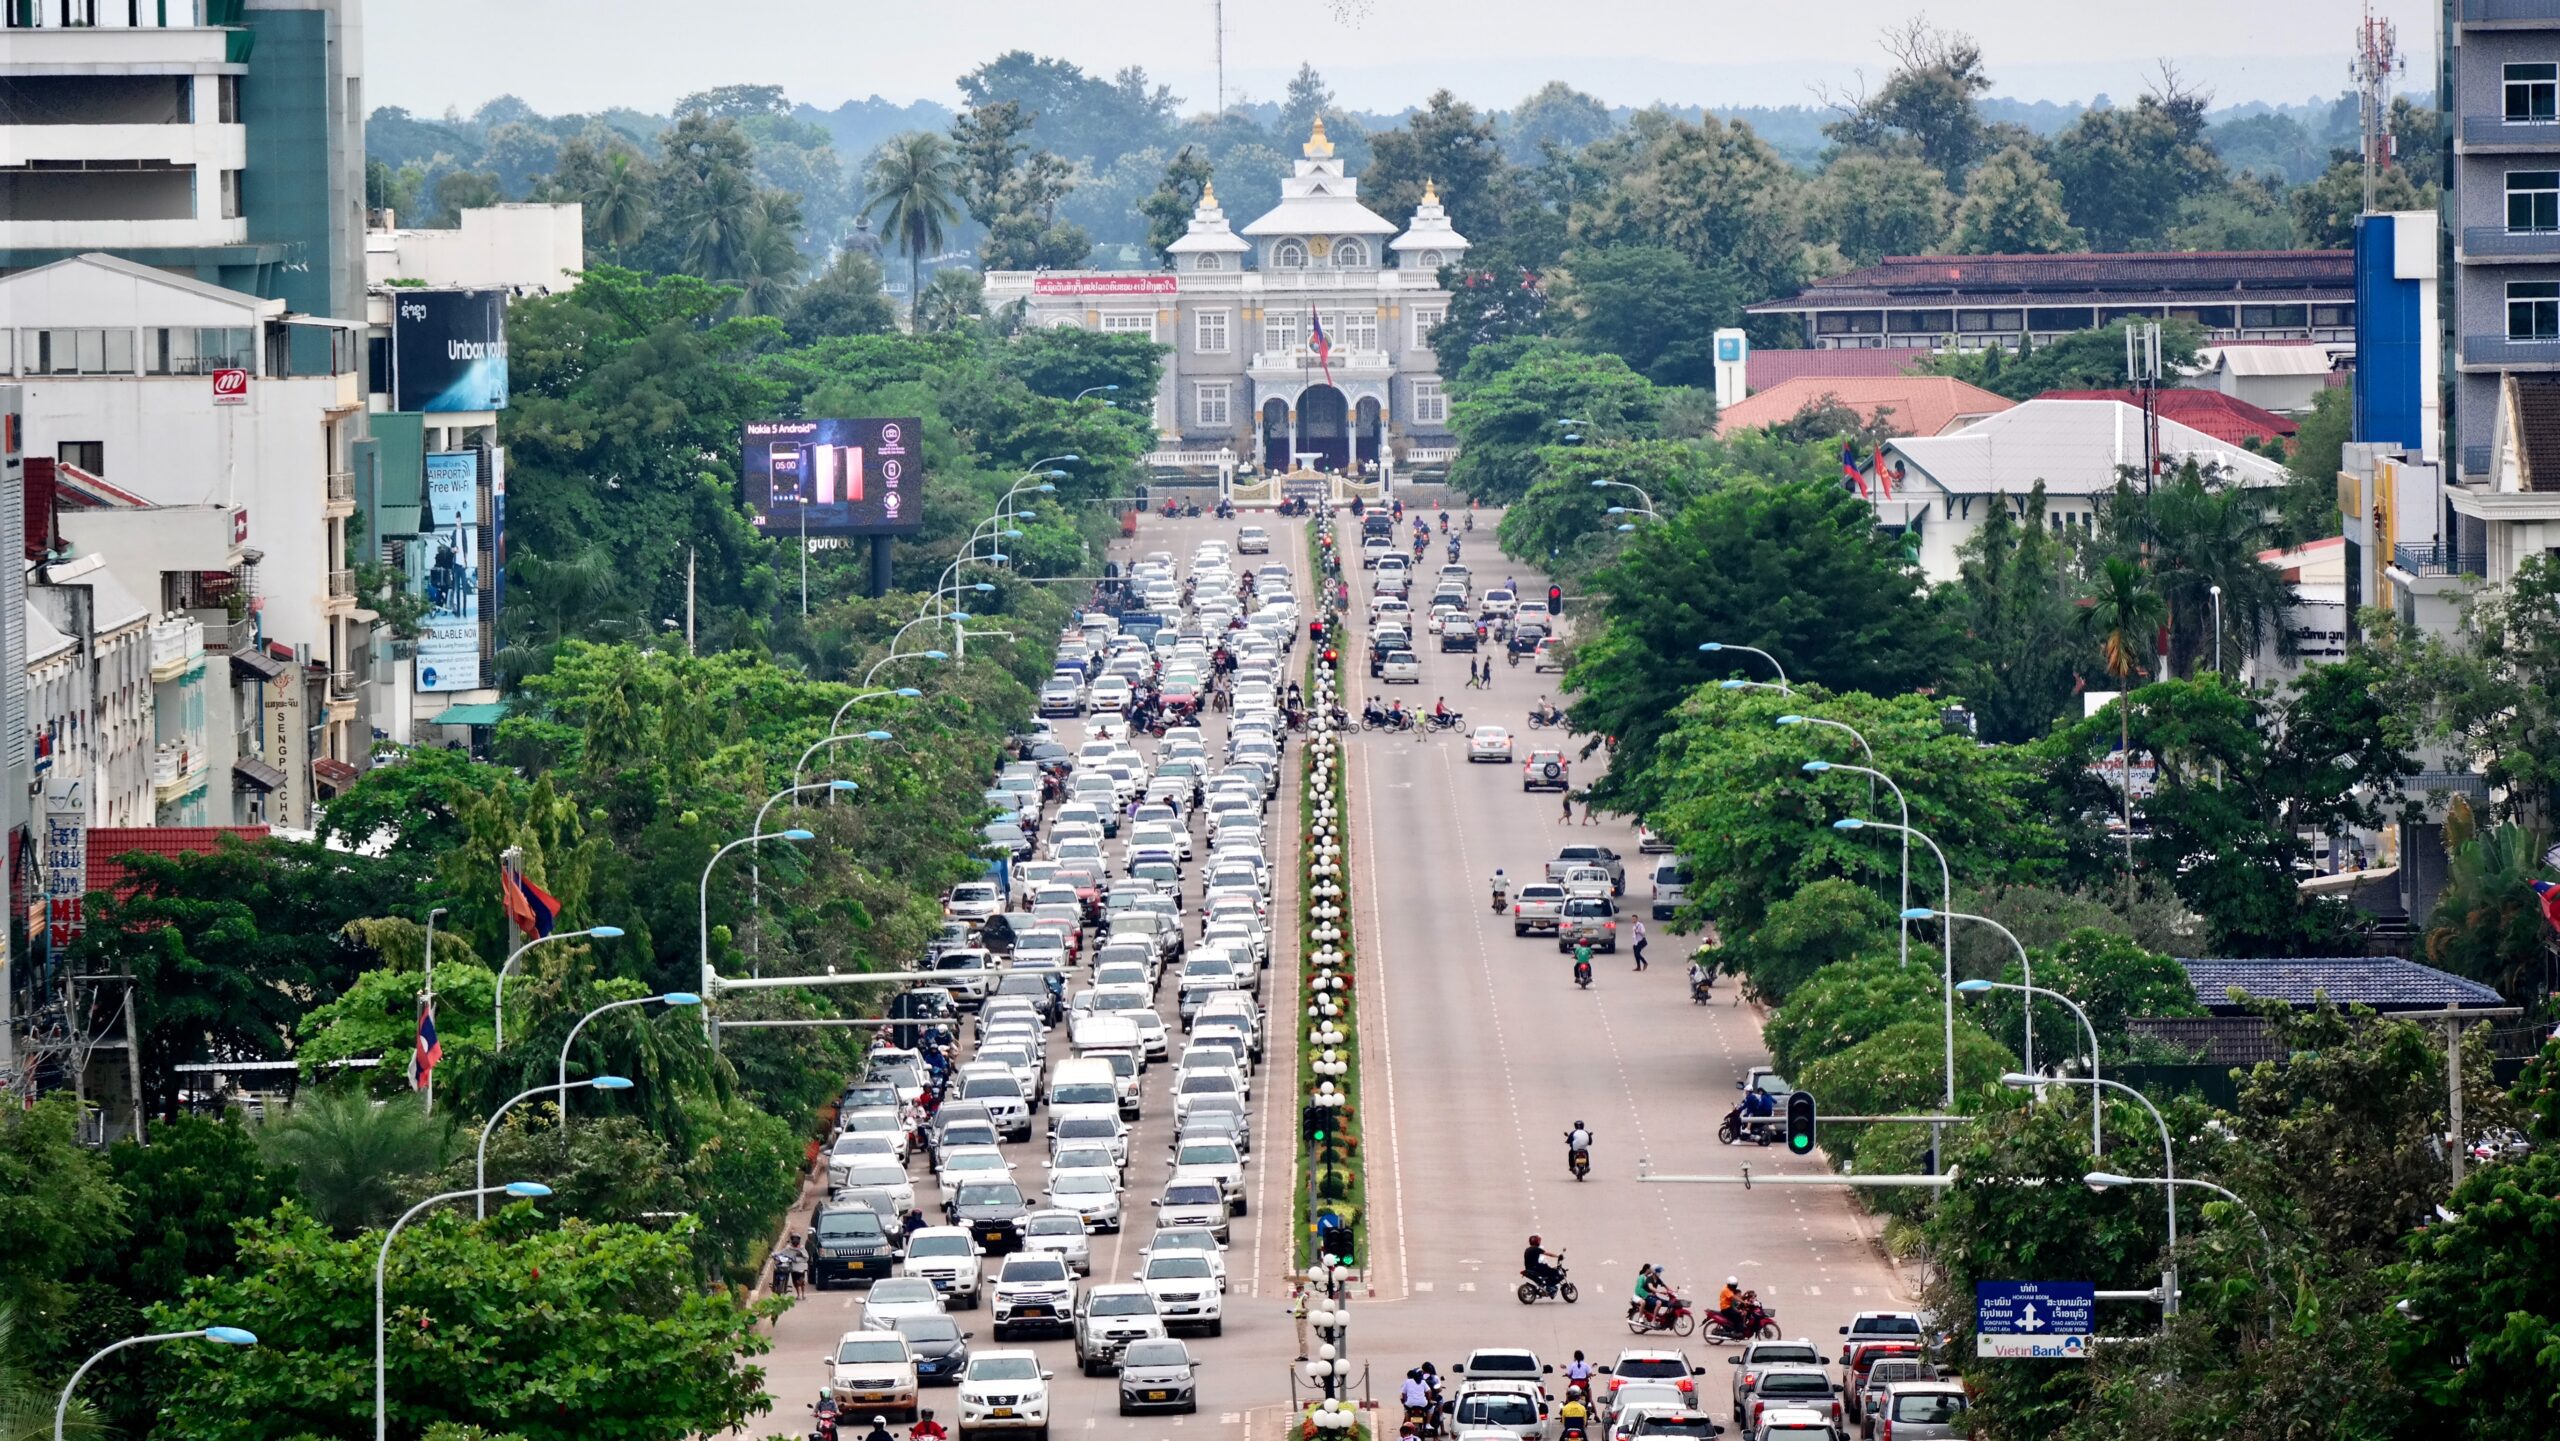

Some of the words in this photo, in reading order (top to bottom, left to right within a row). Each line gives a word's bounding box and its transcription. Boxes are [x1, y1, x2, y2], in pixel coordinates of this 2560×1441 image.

[448, 339, 485, 360] Unbox
[747, 424, 771, 434] Nokia
[772, 424, 778, 434] 5
[428, 469, 461, 480] AIRPORT
[429, 481, 449, 493] Free
[451, 480, 470, 492] Wi-Fi
[463, 628, 477, 638] NOW
[1995, 1345, 2064, 1356] VietinBank
